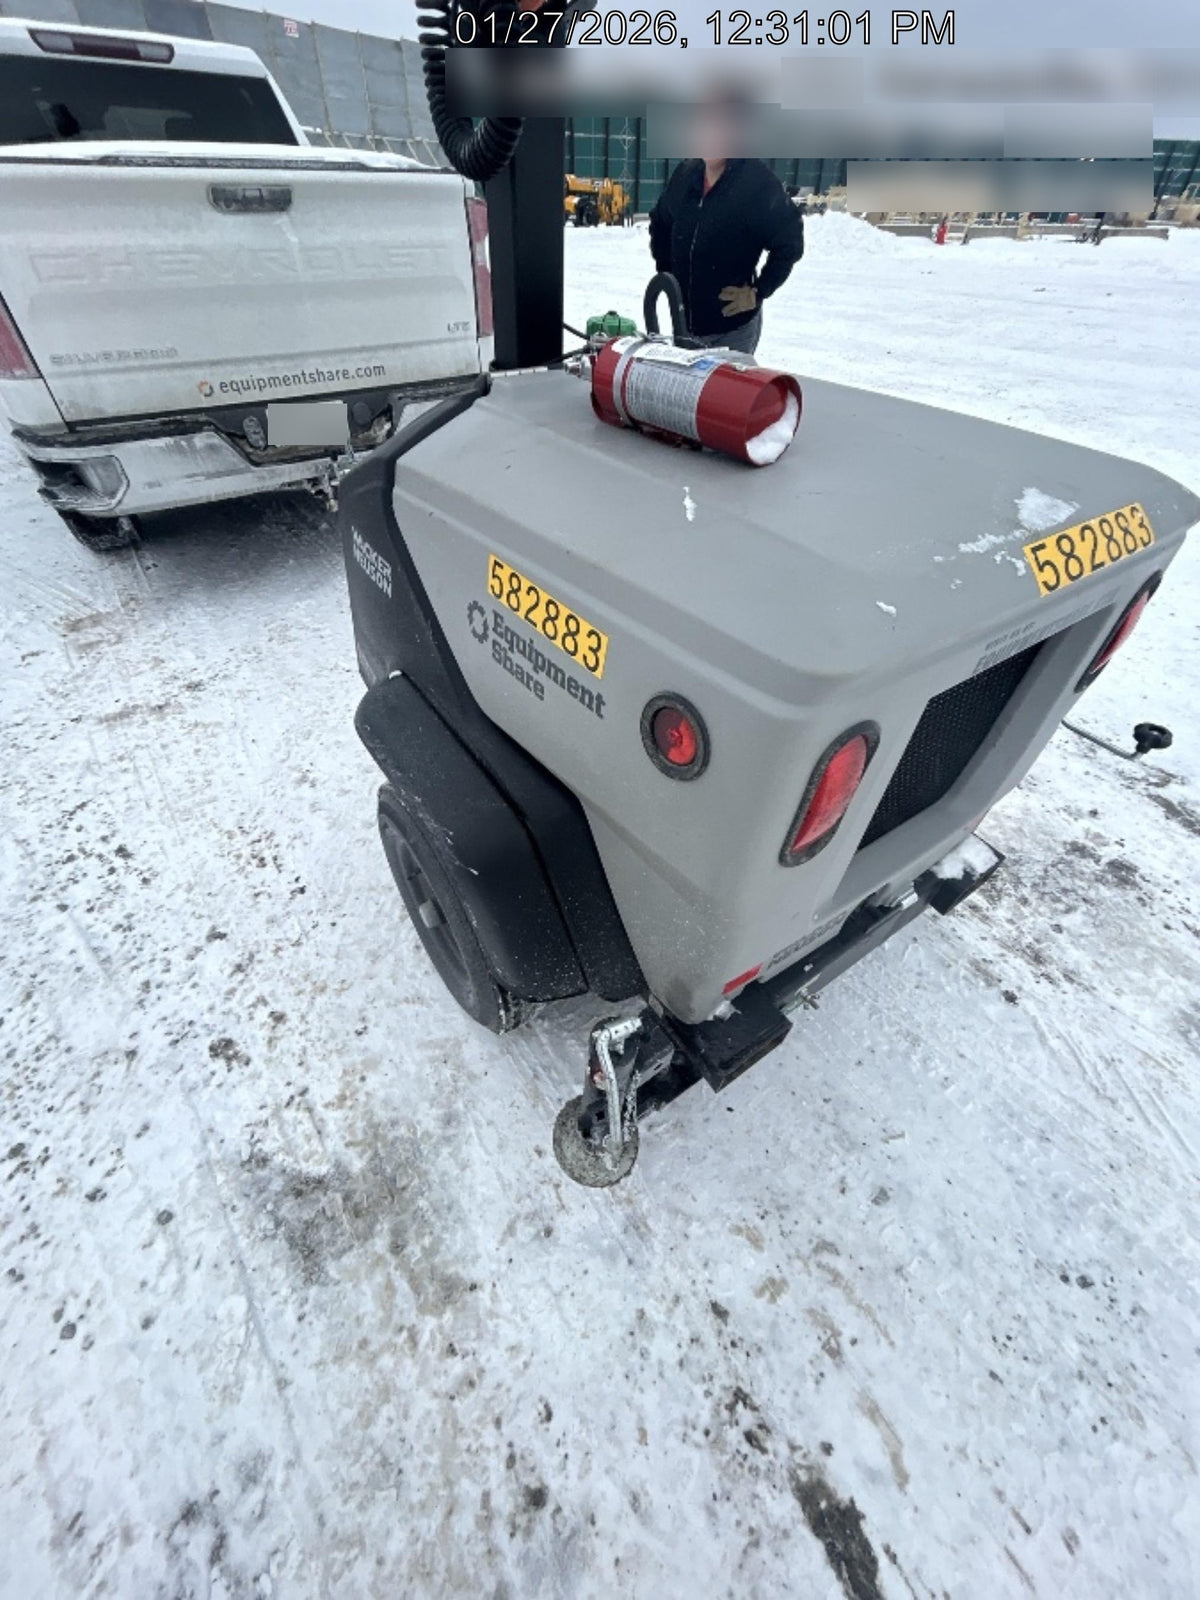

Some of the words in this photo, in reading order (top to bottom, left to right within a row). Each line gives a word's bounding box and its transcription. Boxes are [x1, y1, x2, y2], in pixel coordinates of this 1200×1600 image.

[218, 363, 387, 396] equipmentshare.com
[1030, 506, 1152, 592] 582883
[490, 559, 602, 673] 582883
[492, 609, 606, 719] Equipment
[492, 639, 545, 701] Share
